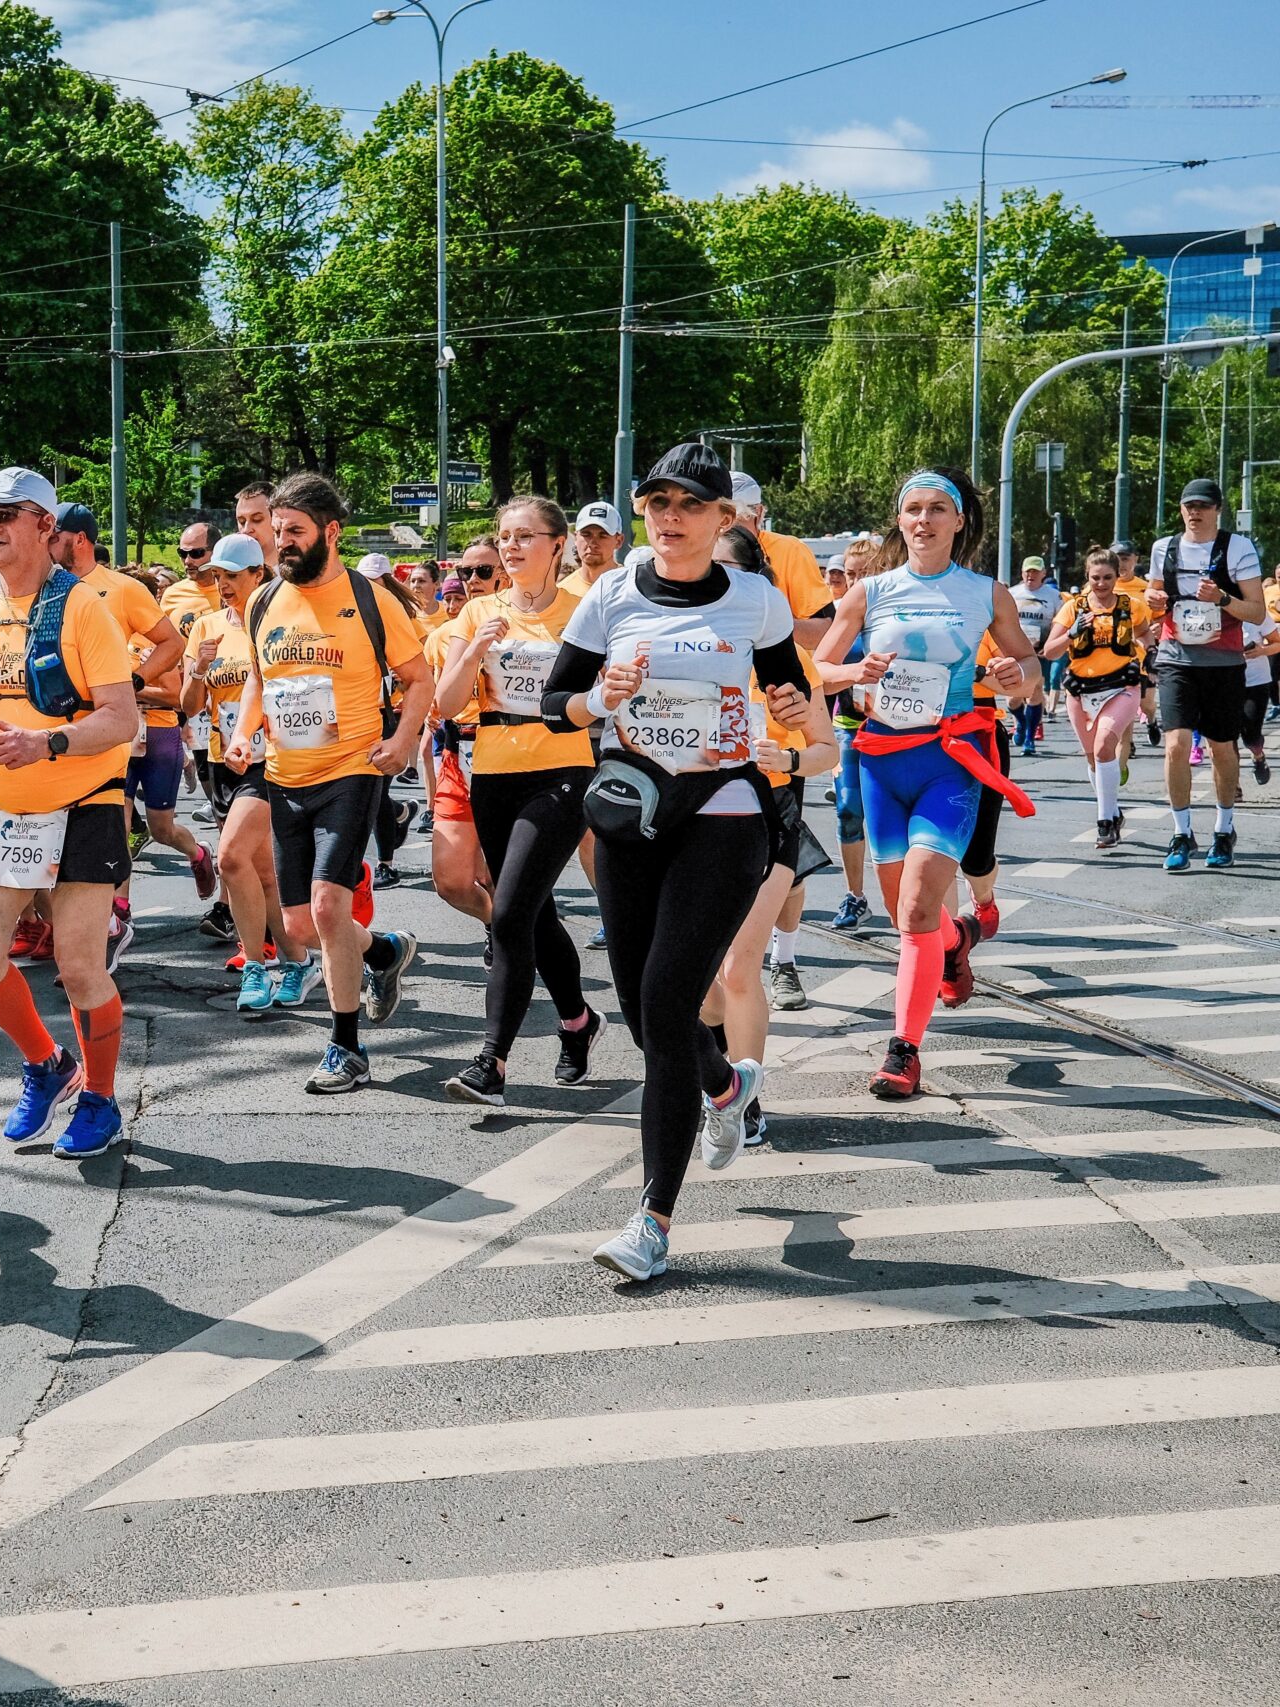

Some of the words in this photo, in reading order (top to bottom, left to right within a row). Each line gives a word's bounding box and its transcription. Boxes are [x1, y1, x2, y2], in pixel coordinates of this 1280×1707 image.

[393, 491, 414, 499] Górna
[1182, 623, 1212, 632] 12743
[674, 642, 711, 652] ING
[272, 647, 314, 662] WORLD
[316, 648, 344, 664] RUN
[213, 670, 248, 686] WORLD
[896, 674, 920, 682] WINGS
[507, 693, 540, 702] Marcelina
[880, 695, 924, 714] 9796
[935, 704, 942, 712] 4
[276, 711, 322, 728] 19266
[328, 710, 336, 720] 3
[890, 713, 909, 722] Anna
[289, 729, 309, 737] Dawid
[627, 726, 700, 748] 23862
[709, 731, 718, 745] 4
[652, 749, 674, 758] Ilona
[1, 846, 43, 864] 7596
[53, 848, 60, 860] 3
[10, 866, 30, 874] Józek
